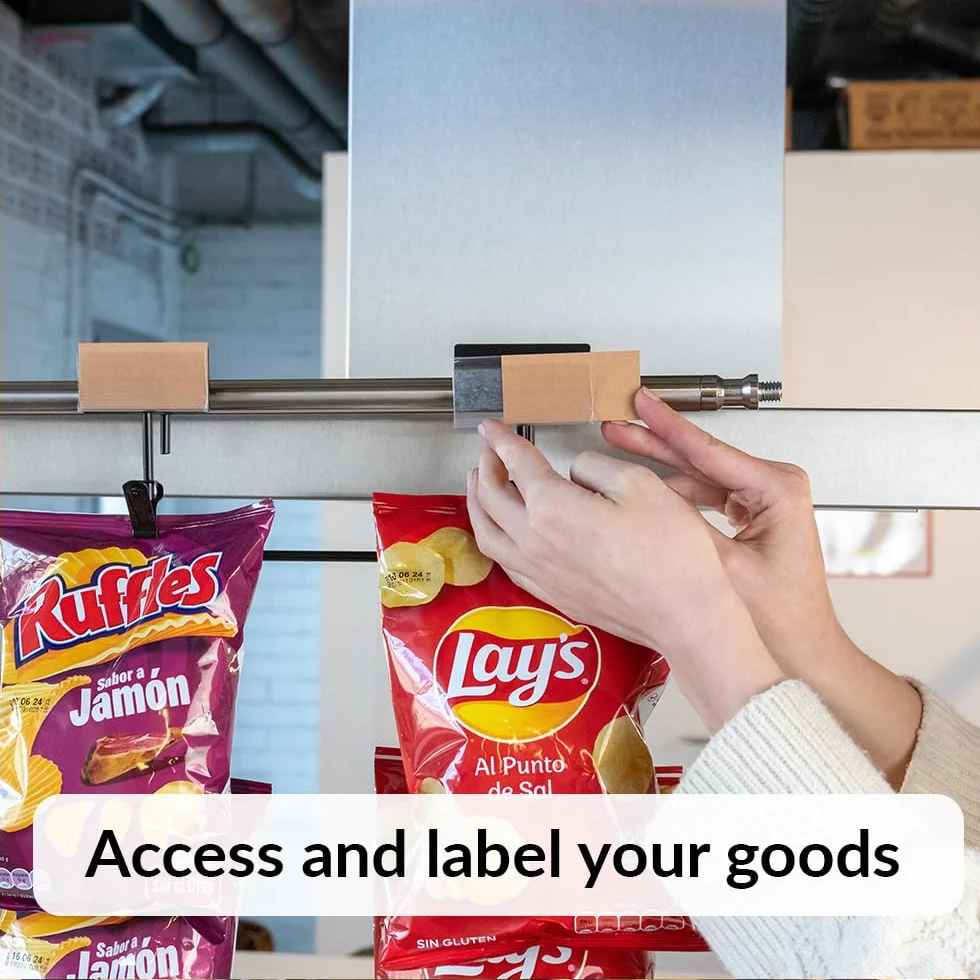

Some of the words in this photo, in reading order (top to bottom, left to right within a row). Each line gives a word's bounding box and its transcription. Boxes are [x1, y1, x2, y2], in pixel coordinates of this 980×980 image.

[14, 552, 223, 668] Ruffles
[447, 632, 588, 707] Lay's
[97, 670, 134, 691] Sabor
[70, 667, 191, 727] Jamón
[475, 756, 496, 776] Al
[503, 756, 565, 775] Punto
[488, 781, 514, 797] de
[520, 779, 552, 797] Sal
[96, 940, 130, 958] Sabor
[416, 938, 439, 949] SIN
[441, 935, 498, 948] GLUTEN
